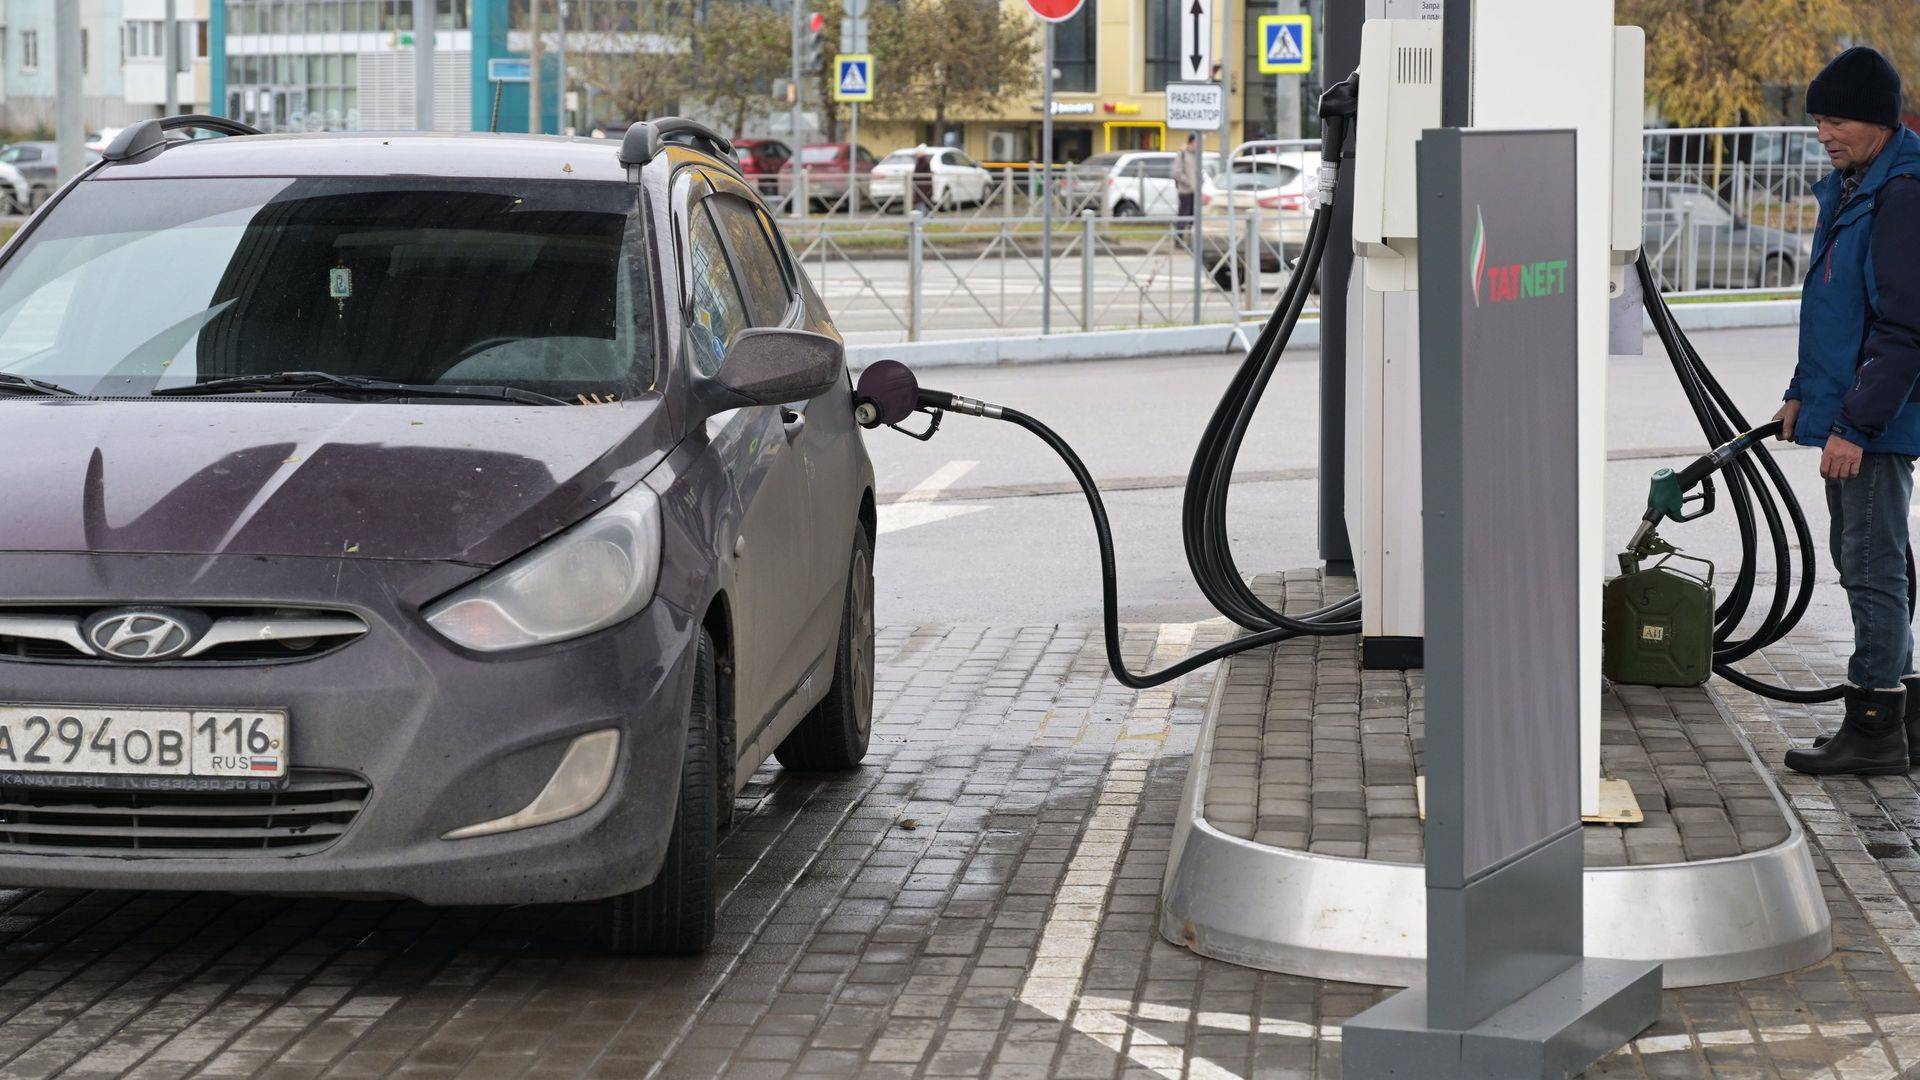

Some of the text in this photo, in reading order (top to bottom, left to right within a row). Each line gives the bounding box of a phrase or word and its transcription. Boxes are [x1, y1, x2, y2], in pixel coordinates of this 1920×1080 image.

[1171, 92, 1217, 104] РАБОТАЕТ
[1169, 109, 1219, 120] ЭВАКУАТОР
[1488, 259, 1568, 303] TATNEFT
[197, 716, 270, 754] 116
[212, 756, 249, 770] RUS
